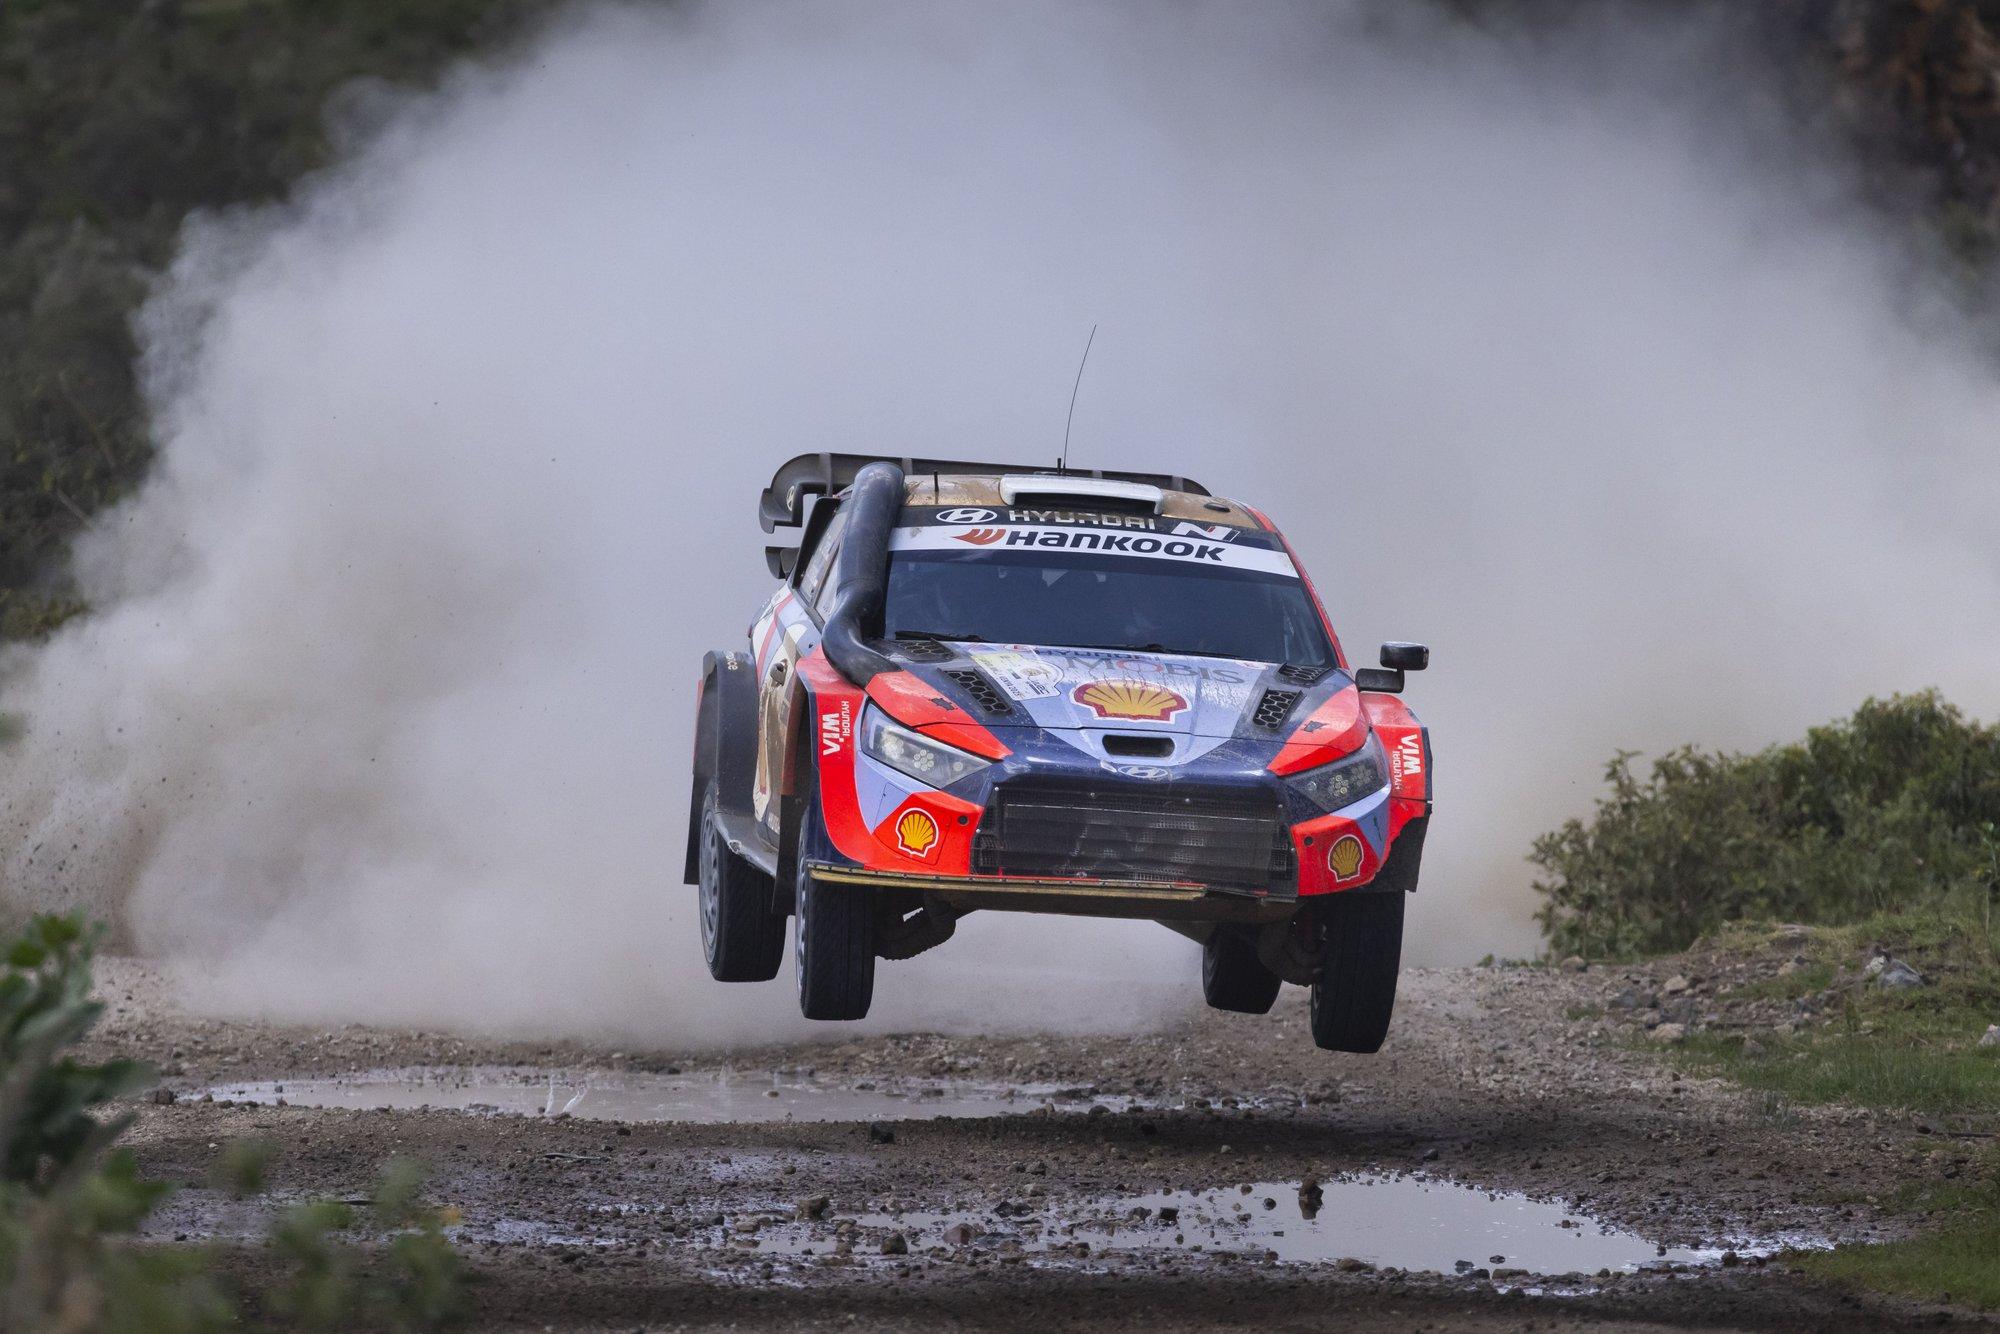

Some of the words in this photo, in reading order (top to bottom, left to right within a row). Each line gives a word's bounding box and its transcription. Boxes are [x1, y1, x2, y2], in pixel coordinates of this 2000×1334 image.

[1009, 510, 1156, 530] HYUNDAI
[1066, 656, 1245, 684] MOBIS
[841, 700, 851, 737] HYUNDAI
[1392, 750, 1402, 790] HYUNDAI
